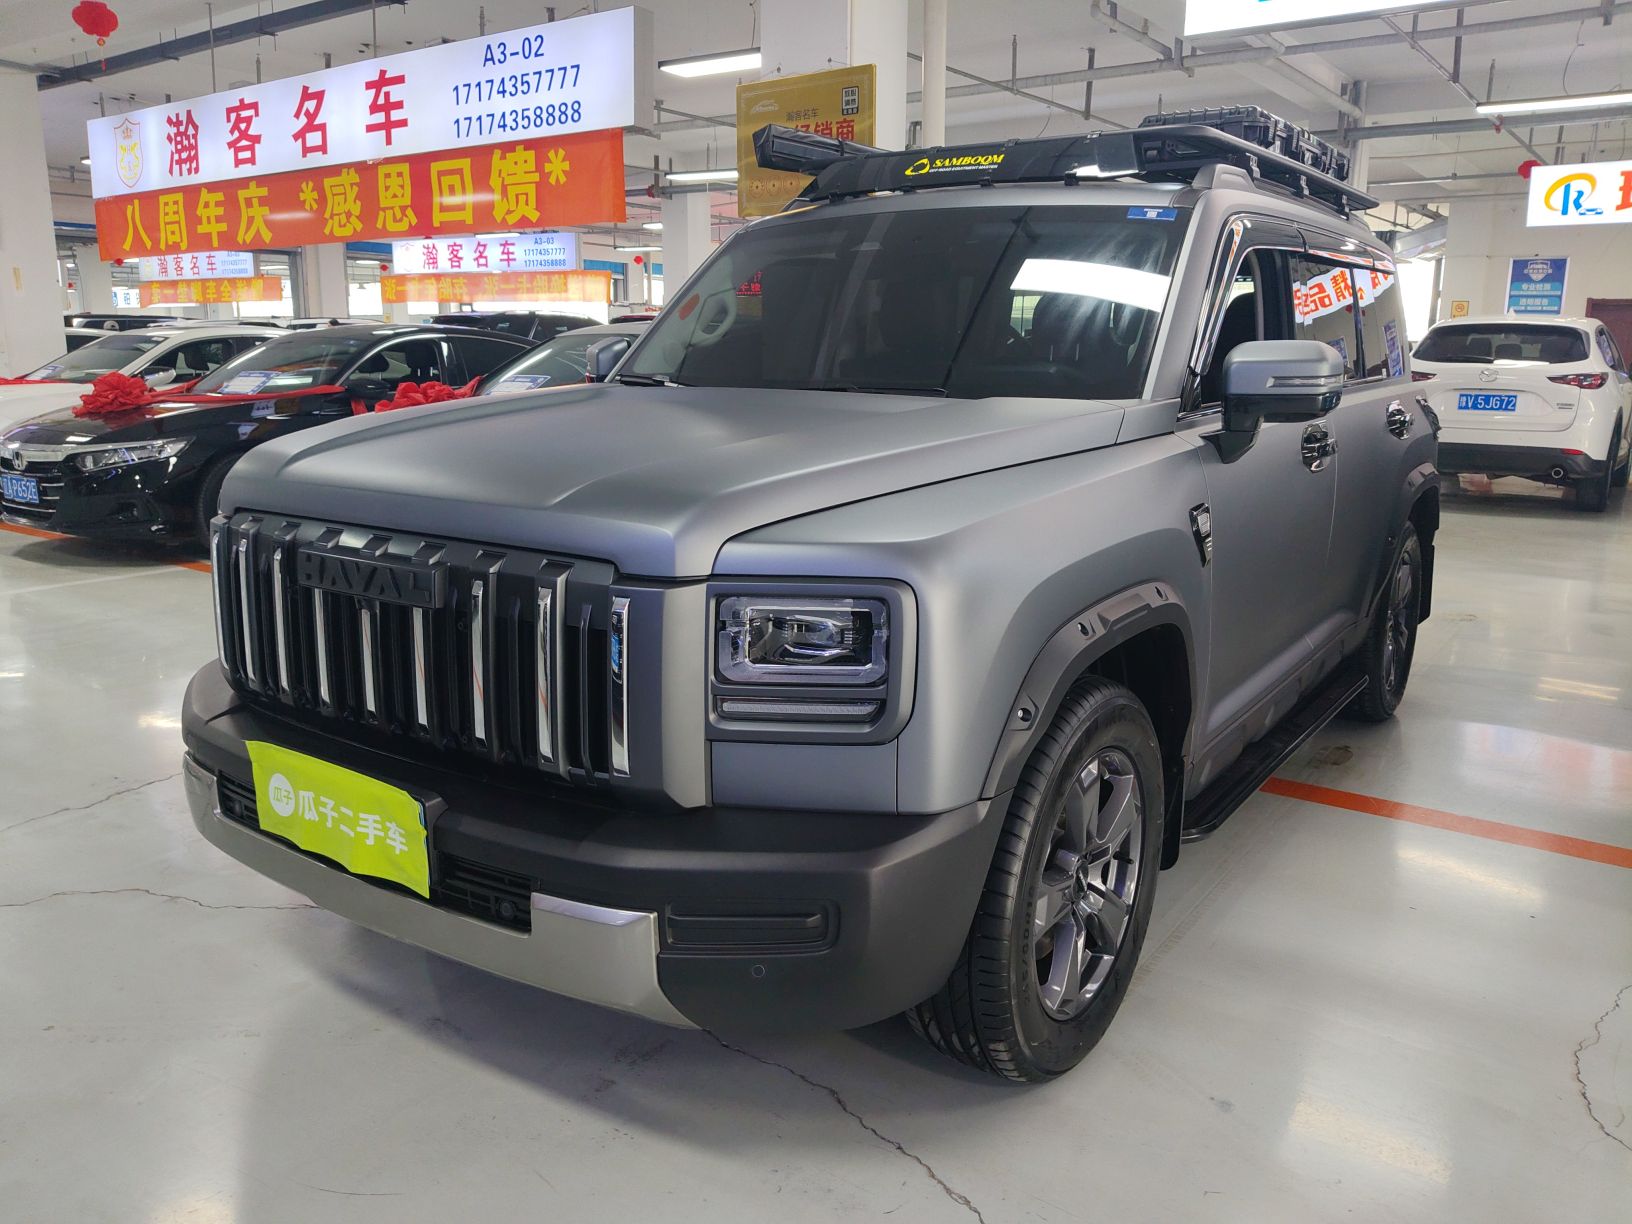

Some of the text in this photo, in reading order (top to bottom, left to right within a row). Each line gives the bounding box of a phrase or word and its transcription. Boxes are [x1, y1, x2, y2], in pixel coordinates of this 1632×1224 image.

[482, 34, 545, 68] A3-02
[452, 64, 582, 107] 17174357777
[166, 69, 409, 177] 瀚客名车
[453, 101, 583, 140] 17174358888
[122, 179, 272, 253] 八周年庆
[422, 240, 517, 270] 瀚客名车
[523, 248, 566, 257] 17174357777
[534, 237, 555, 246] A3-03
[524, 259, 567, 268] 17174358888
[299, 552, 432, 604] HAVAL
[273, 786, 292, 805] 瓜子
[298, 791, 408, 854] 瓜子二手车
